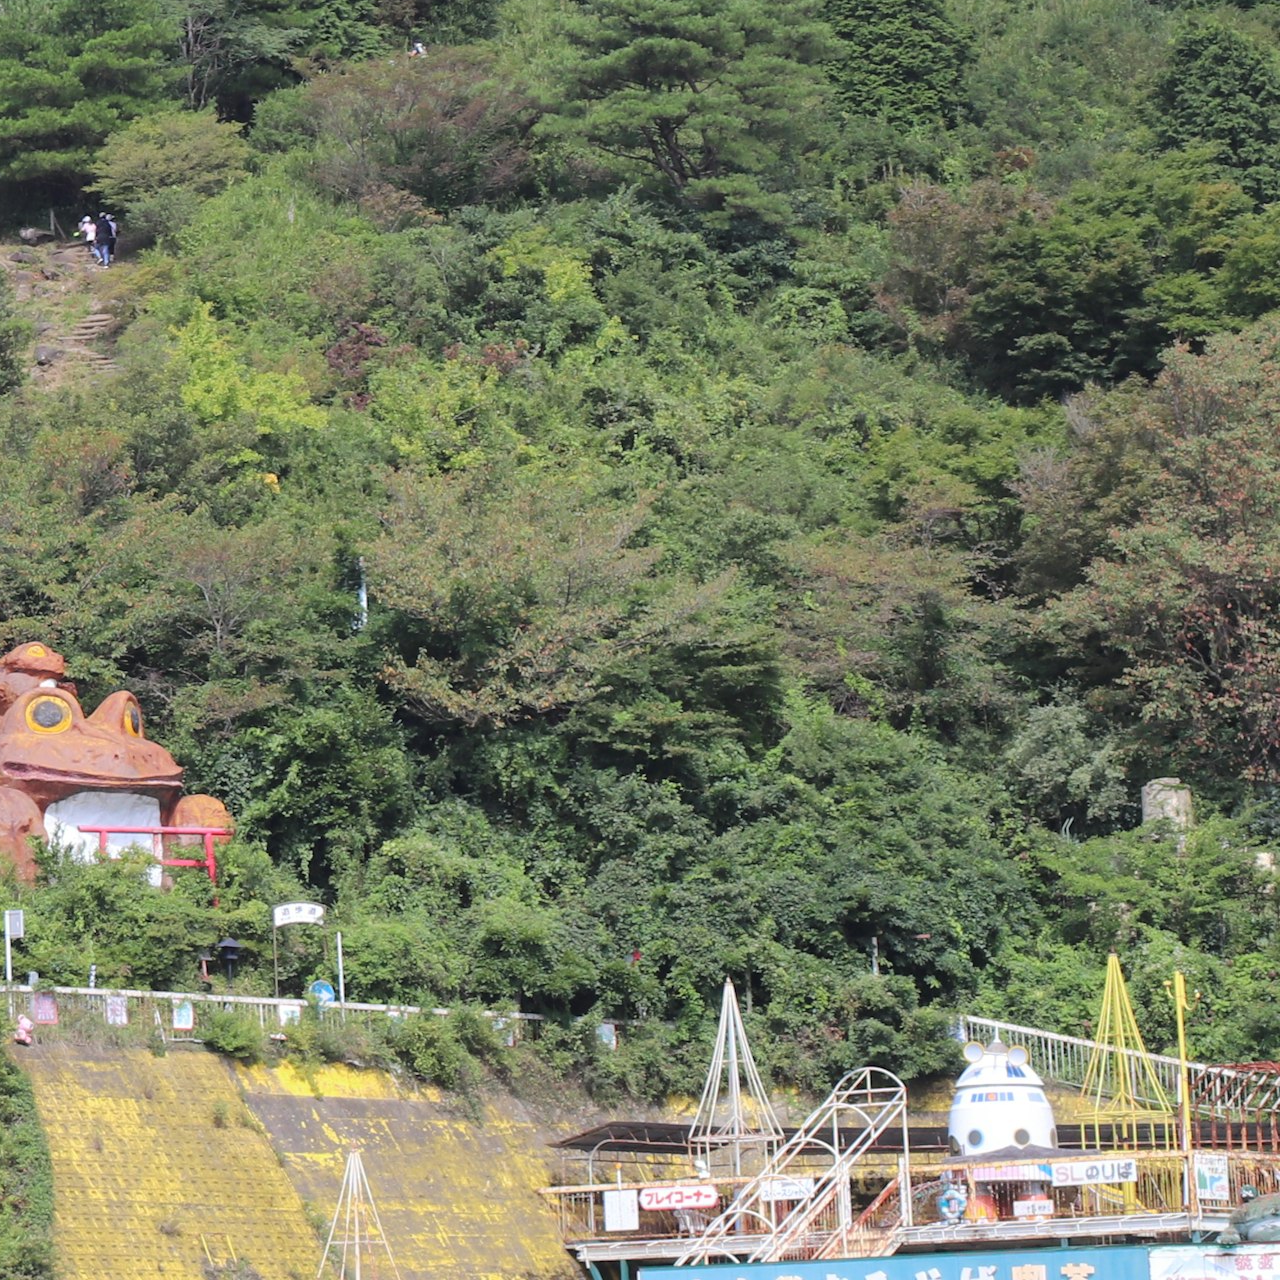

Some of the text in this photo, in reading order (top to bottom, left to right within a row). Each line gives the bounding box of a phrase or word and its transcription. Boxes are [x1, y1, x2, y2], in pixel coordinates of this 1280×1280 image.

[644, 1190, 712, 1205] プレイコーナー
